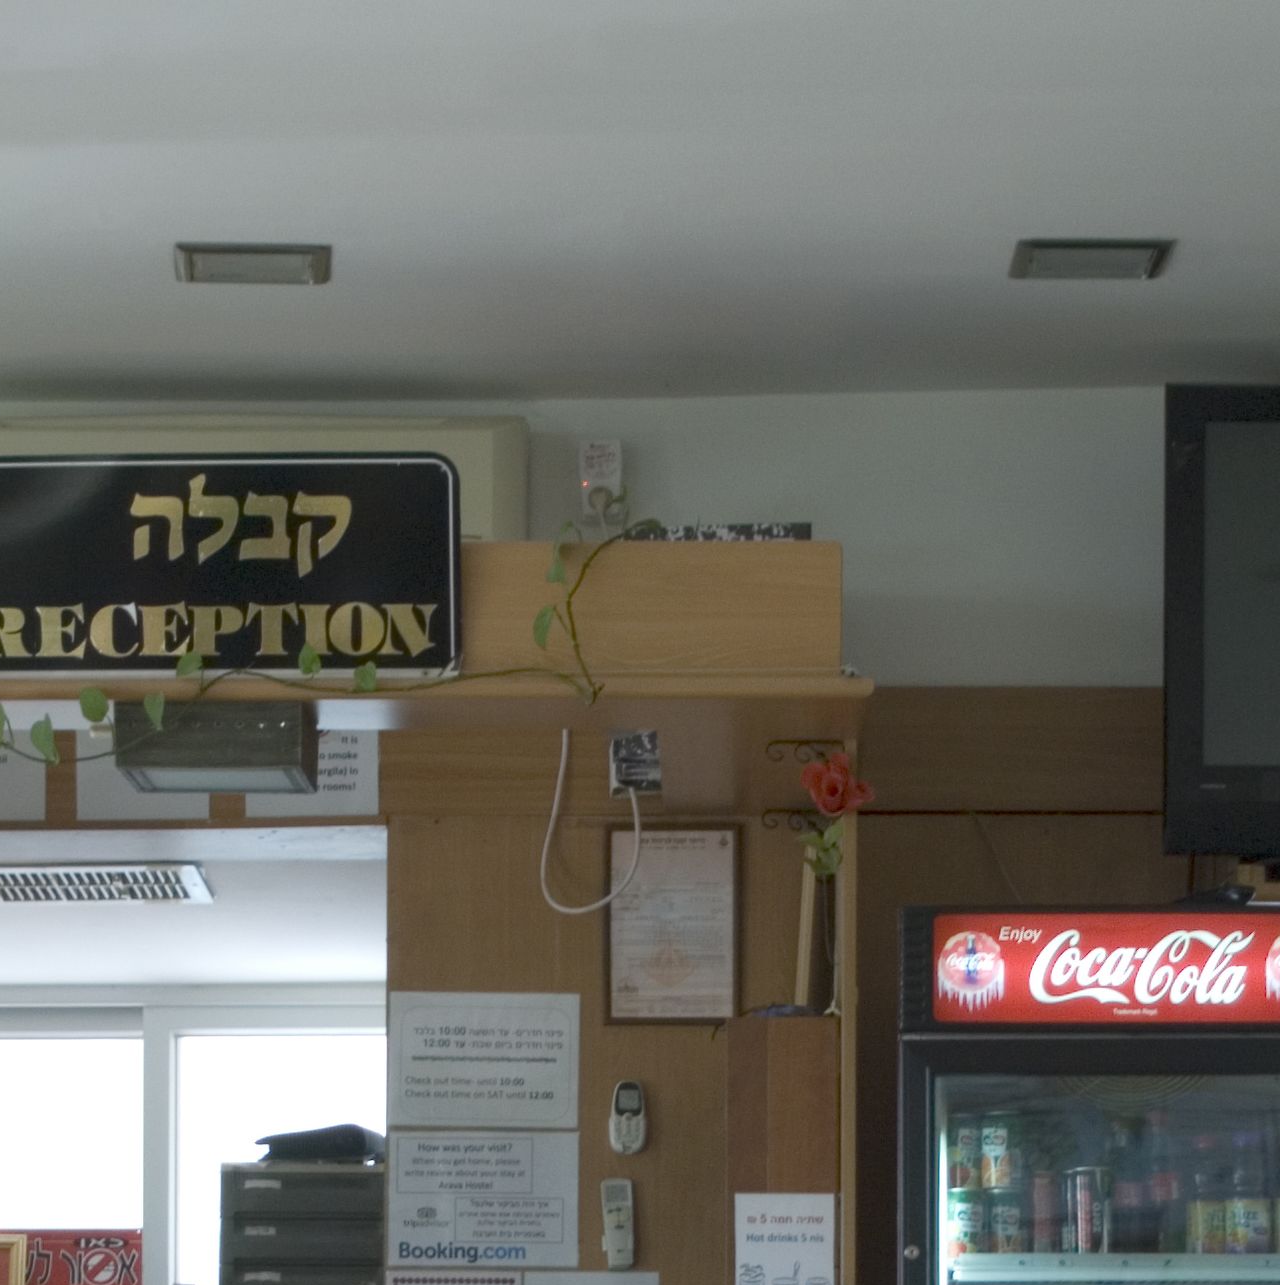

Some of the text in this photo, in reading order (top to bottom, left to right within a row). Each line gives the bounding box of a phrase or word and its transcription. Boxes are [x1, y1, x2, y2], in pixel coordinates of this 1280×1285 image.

[130, 473, 352, 578] קבלה
[998, 925, 1043, 945] Enjoy
[944, 952, 995, 971] Coca-Cola
[1028, 928, 1257, 1005] Coca-Cola
[439, 1026, 466, 1037] 10:00
[423, 1038, 450, 1049] 12:00
[405, 1075, 431, 1085] Check
[433, 1077, 449, 1087] out
[476, 1077, 497, 1086] until
[499, 1077, 524, 1087] 10:00
[405, 1089, 431, 1099] Check
[433, 1090, 449, 1100] out
[451, 1090, 471, 1100] time
[487, 1090, 504, 1100] SAT
[505, 1090, 527, 1100] until
[528, 1090, 554, 1100] 12:00
[418, 1143, 513, 1154] How was your visit?
[438, 1181, 463, 1190] Arava
[760, 1213, 767, 1225] 5
[746, 1231, 825, 1243] Hot drinks 5 nis
[398, 1241, 527, 1263] Booking.com
